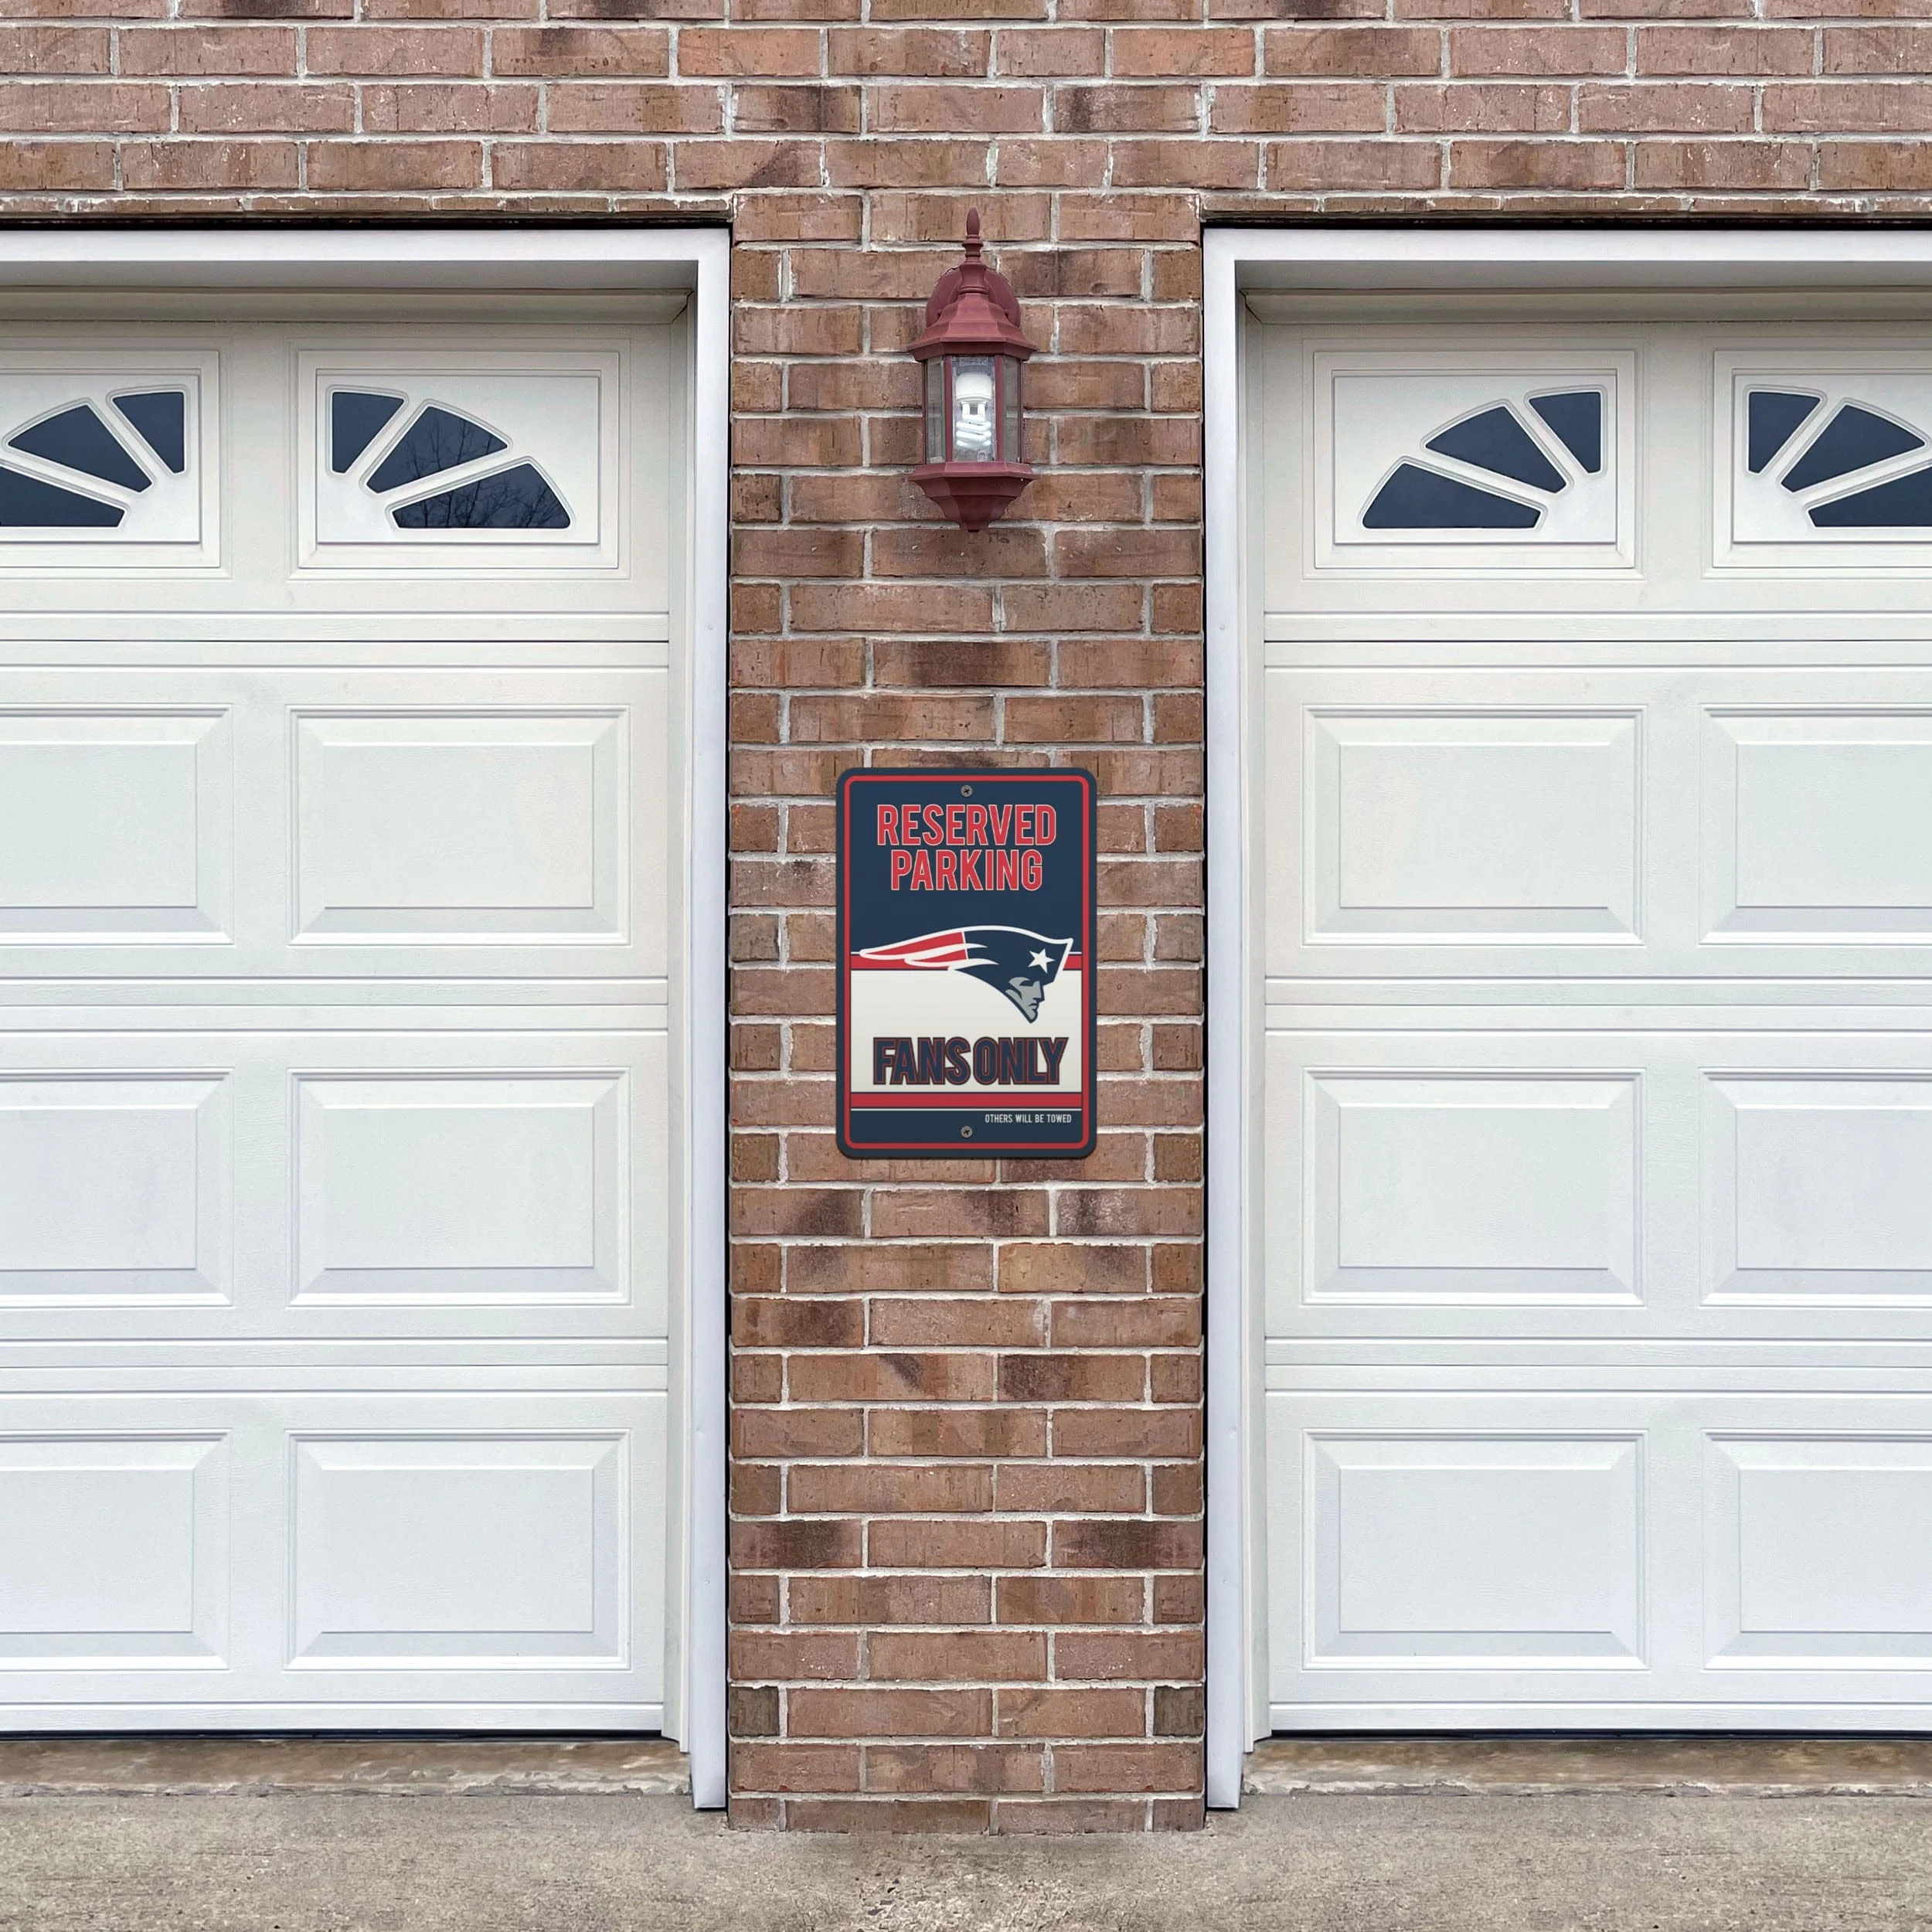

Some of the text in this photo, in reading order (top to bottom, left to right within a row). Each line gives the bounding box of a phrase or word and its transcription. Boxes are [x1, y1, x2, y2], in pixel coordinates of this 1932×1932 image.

[877, 804, 1056, 846] RESERVED
[891, 849, 1043, 891] PARKING
[872, 1036, 1070, 1086] FANS ONLY
[985, 1114, 1072, 1123] OTHERS WILL BE TOWED
